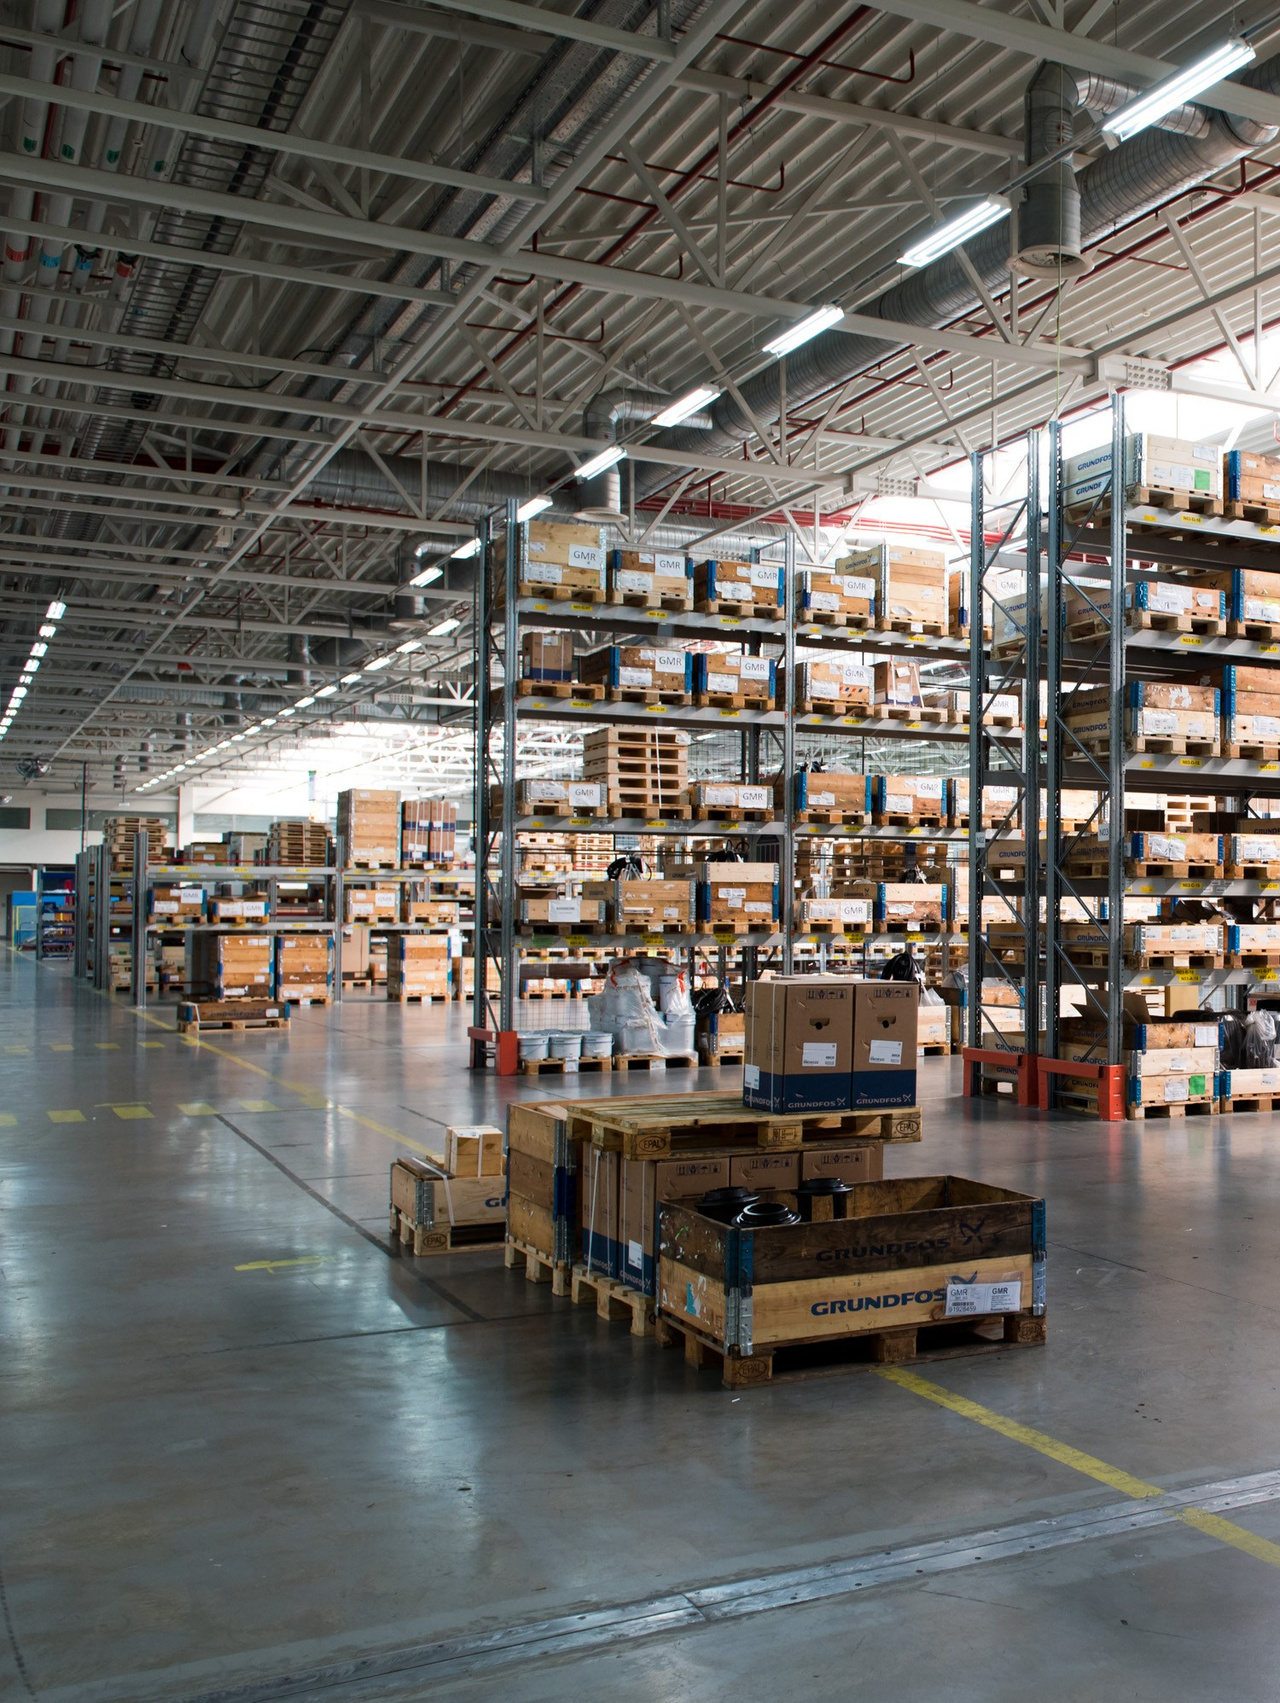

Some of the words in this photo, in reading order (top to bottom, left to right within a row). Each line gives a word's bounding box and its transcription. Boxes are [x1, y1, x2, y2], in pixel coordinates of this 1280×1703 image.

[1076, 482, 1102, 495] GRUNDF
[574, 550, 596, 560] GMR
[660, 560, 680, 570] GMR
[758, 572, 777, 580] GMR
[848, 582, 866, 590] GMR
[659, 656, 682, 666] GMR
[745, 662, 765, 671] GMR
[846, 669, 864, 678] GMR
[1073, 723, 1107, 734] GRUNDFOS
[643, 1138, 662, 1149] EPAL
[426, 1236, 442, 1245] EPAL
[816, 1238, 948, 1262] GRUNDFOS
[810, 1286, 946, 1316] GRUNDFOS
[742, 1362, 762, 1374] EPAL
